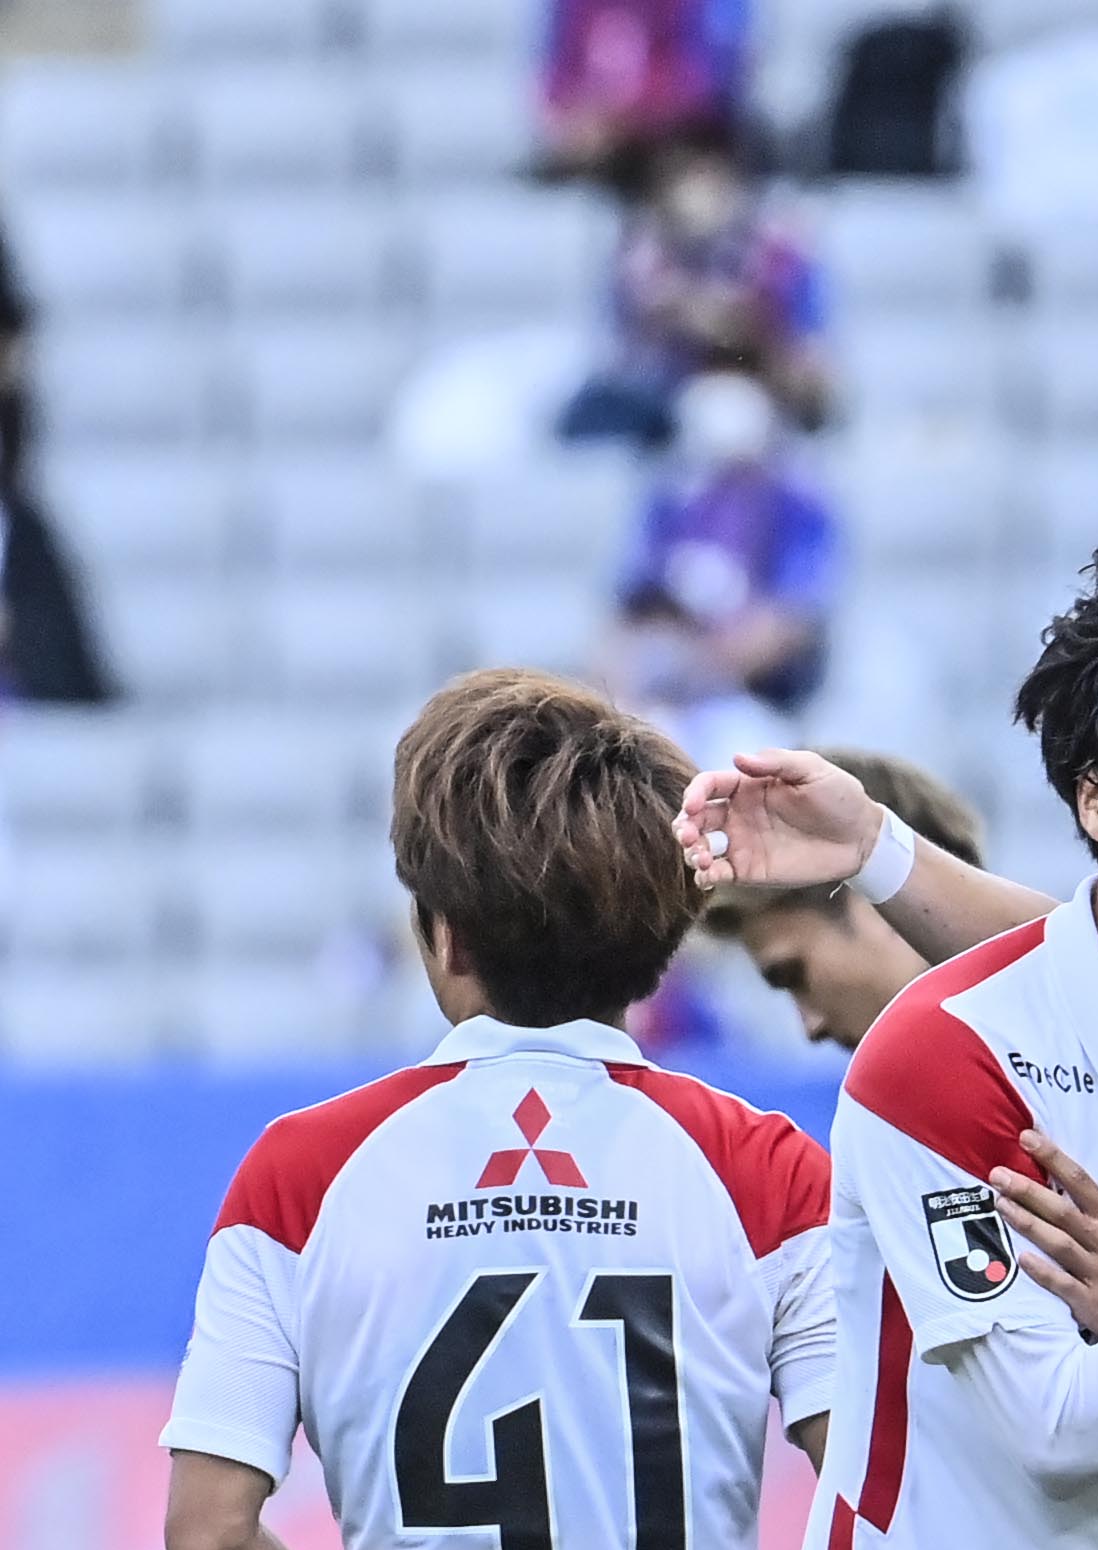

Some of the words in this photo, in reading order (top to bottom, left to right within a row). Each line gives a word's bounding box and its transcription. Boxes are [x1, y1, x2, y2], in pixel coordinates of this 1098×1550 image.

[426, 1195, 639, 1224] MITSUBISHI
[426, 1220, 496, 1240] HEAVY
[503, 1218, 638, 1236] INDUSTRIES
